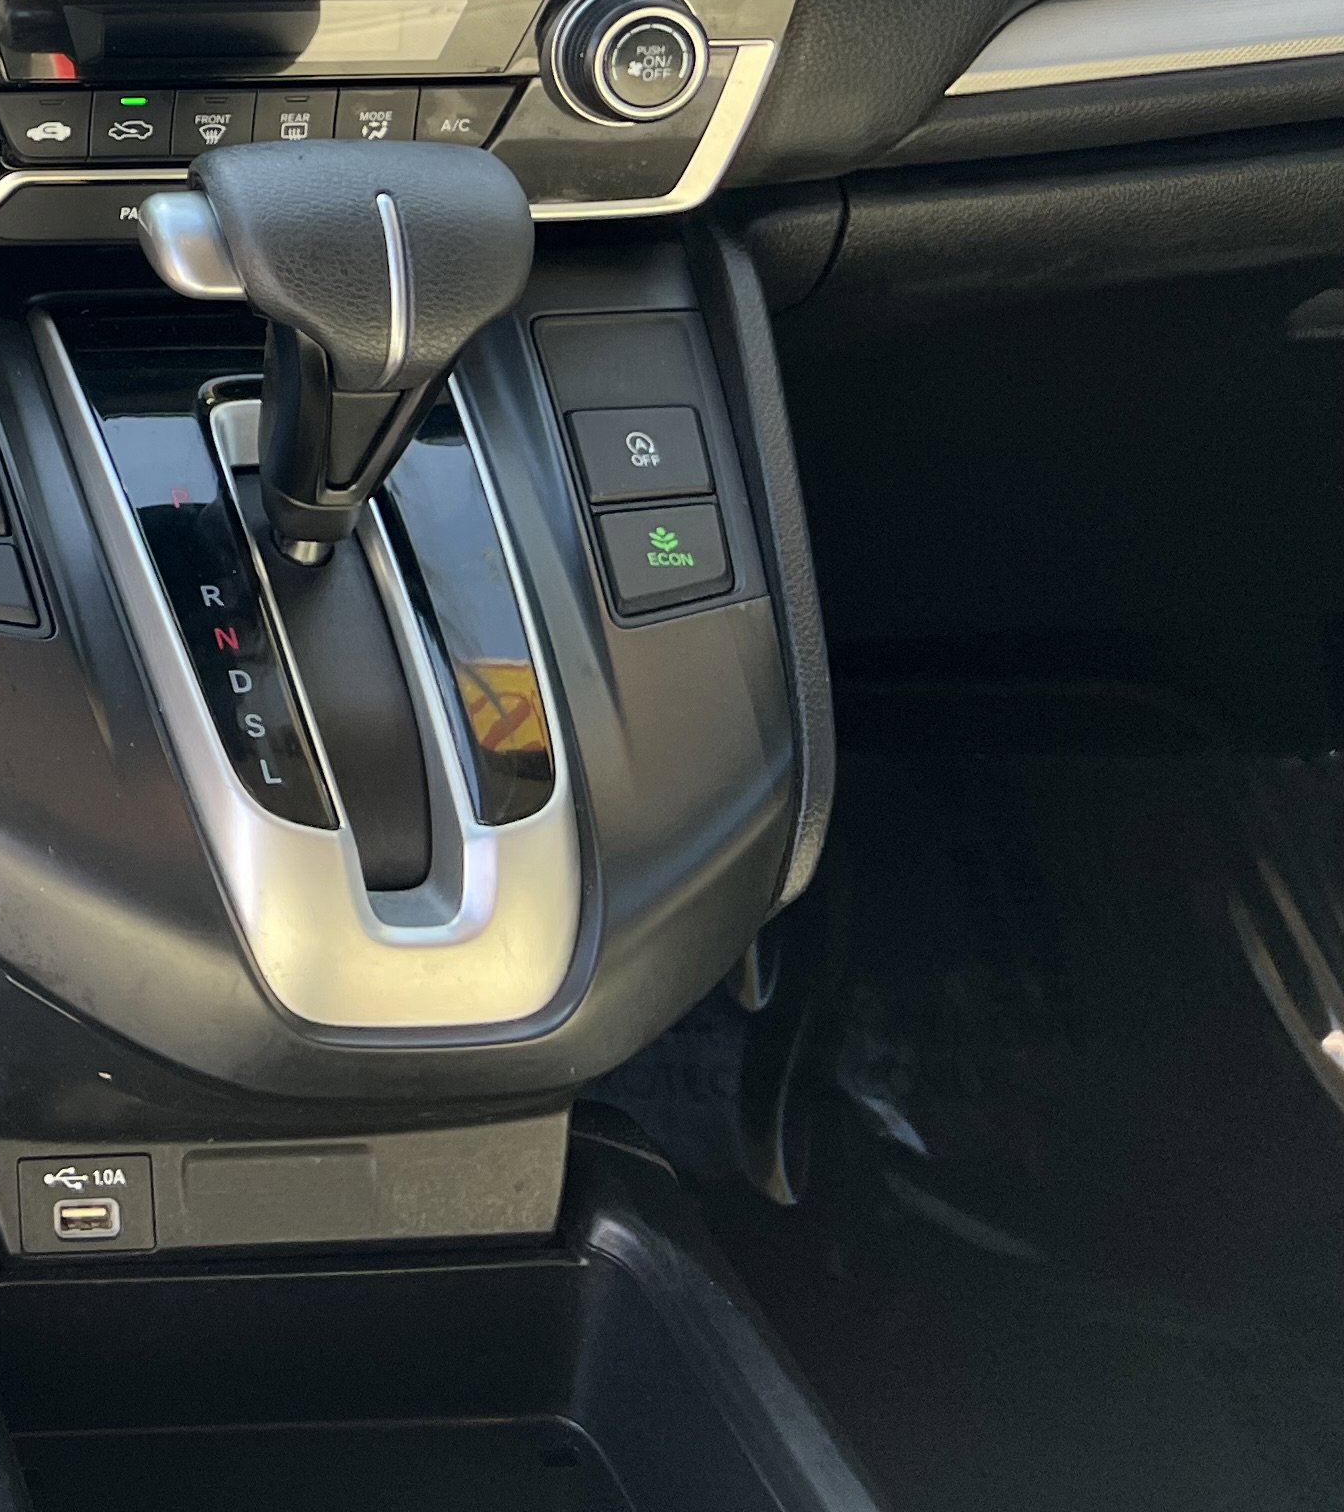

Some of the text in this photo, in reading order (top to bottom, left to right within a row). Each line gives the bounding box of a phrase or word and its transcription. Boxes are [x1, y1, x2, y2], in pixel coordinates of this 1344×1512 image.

[636, 45, 666, 56] PUSH
[642, 54, 672, 69] ON/
[642, 67, 672, 81] OFF
[195, 114, 231, 126] FRONT
[280, 113, 310, 123] REAR
[359, 111, 393, 122] MODE
[440, 118, 471, 133] A/C
[631, 454, 660, 467] OFF
[171, 488, 189, 508] P
[647, 552, 694, 567] ECON
[200, 585, 224, 607] R
[214, 627, 240, 650] N
[228, 669, 252, 693] D
[244, 714, 266, 738] S
[260, 759, 282, 785] L
[92, 1169, 126, 1185] 1.0A
